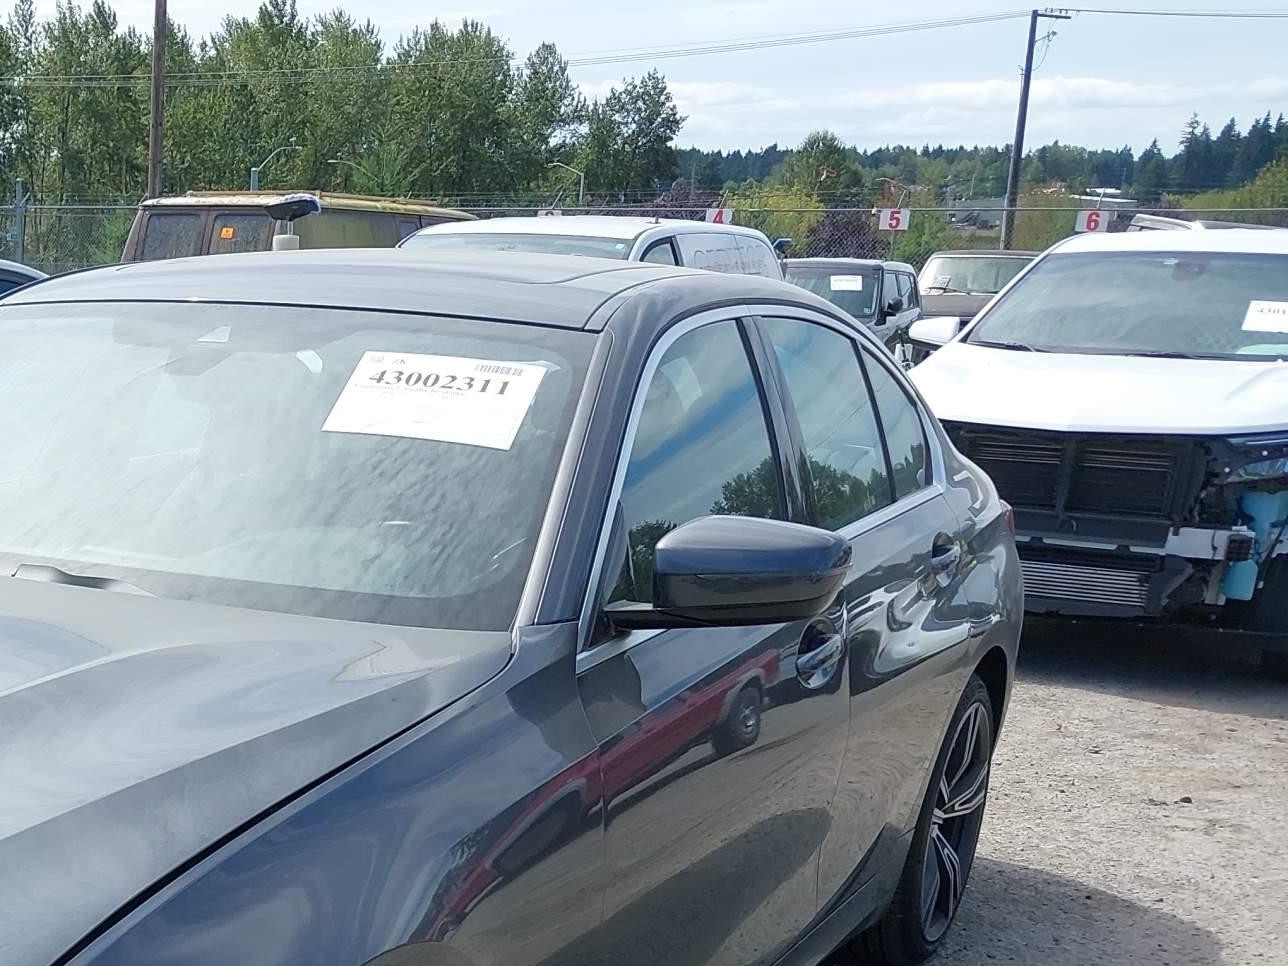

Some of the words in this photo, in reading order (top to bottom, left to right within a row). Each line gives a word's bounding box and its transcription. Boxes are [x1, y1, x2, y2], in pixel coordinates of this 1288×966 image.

[713, 208, 724, 224] 4
[888, 210, 902, 229] 5
[1086, 211, 1100, 231] 6
[369, 369, 511, 396] 43002311
